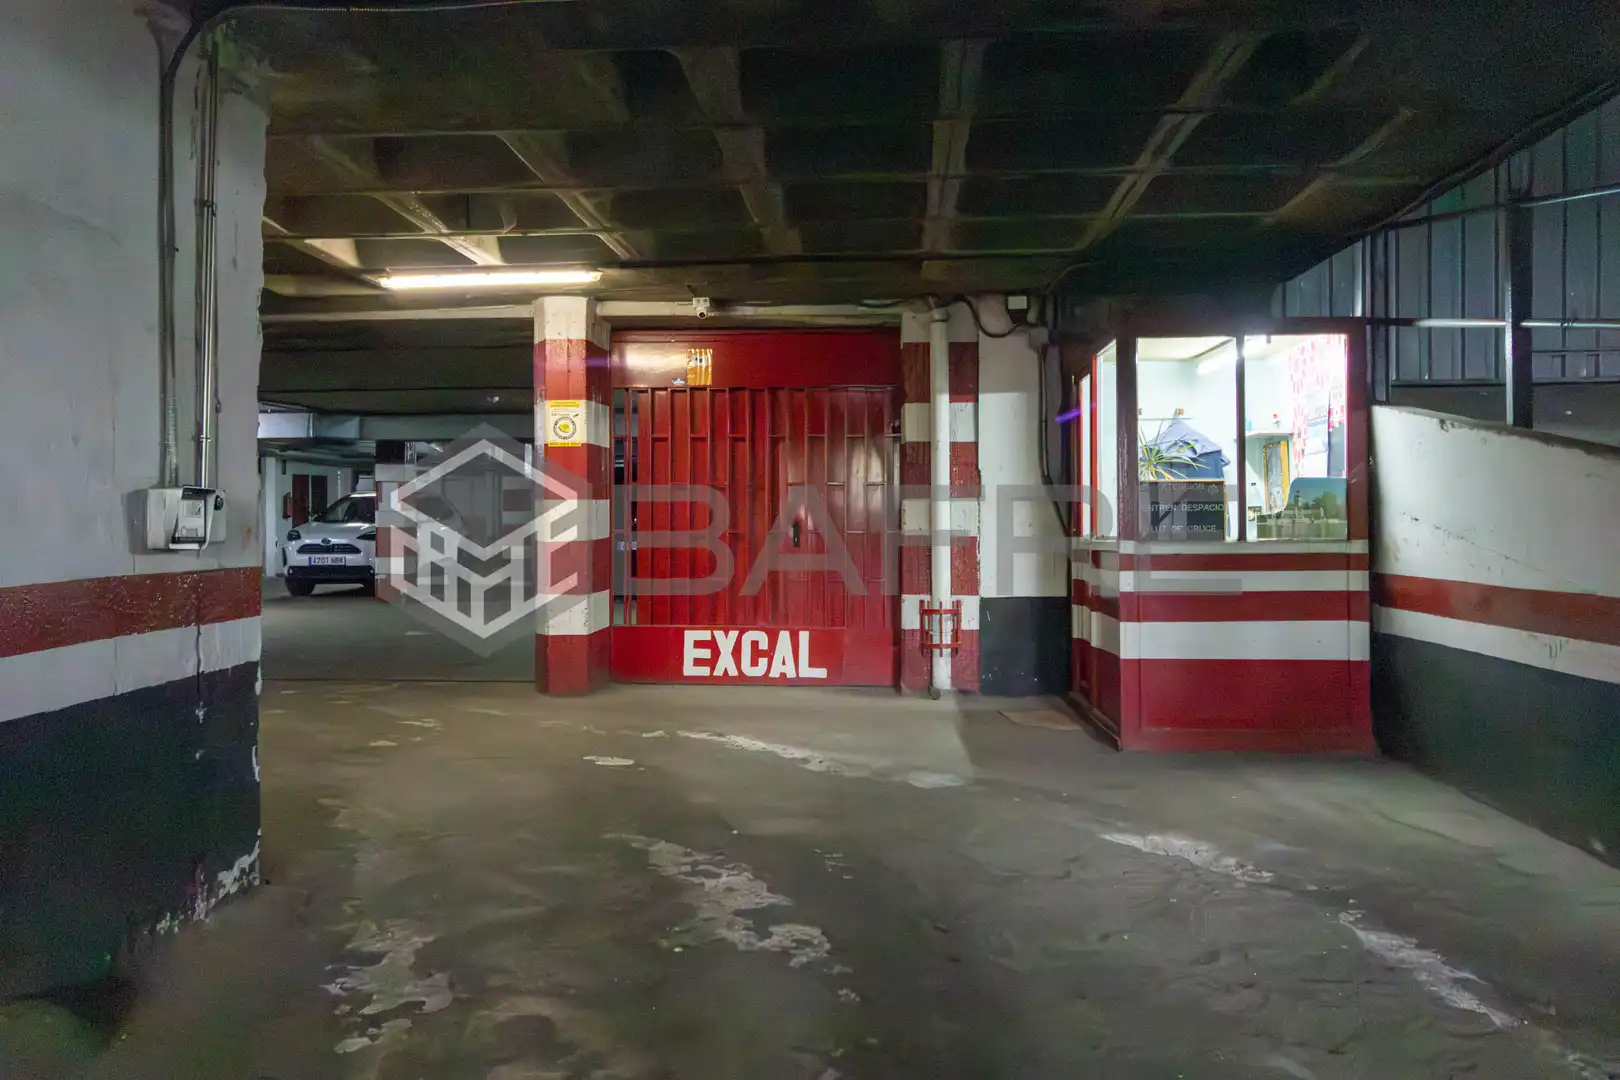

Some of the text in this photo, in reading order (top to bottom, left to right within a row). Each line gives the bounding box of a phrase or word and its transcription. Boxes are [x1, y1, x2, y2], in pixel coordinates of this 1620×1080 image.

[1181, 503, 1224, 512] DESPACIO
[1187, 525, 1217, 533] CRUCE
[683, 630, 828, 678] EXCAL
